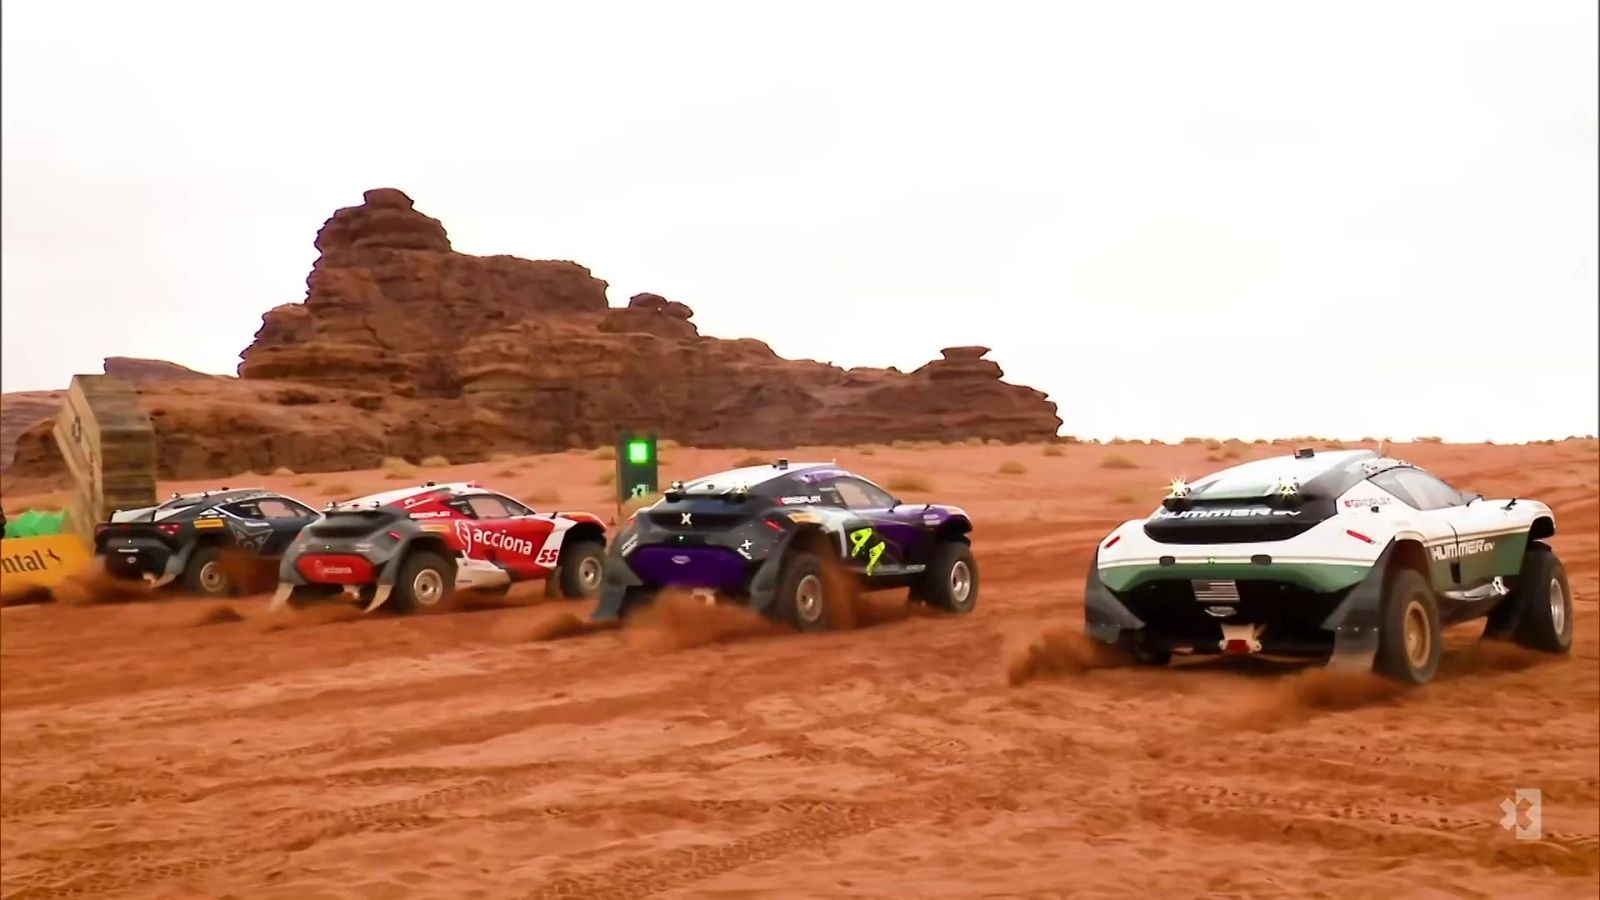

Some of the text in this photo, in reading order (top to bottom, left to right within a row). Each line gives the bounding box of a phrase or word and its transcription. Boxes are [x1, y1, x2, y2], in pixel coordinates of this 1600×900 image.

[473, 528, 533, 555] acciona
[1431, 540, 1485, 561] HUMMER
[538, 549, 558, 563] 55
